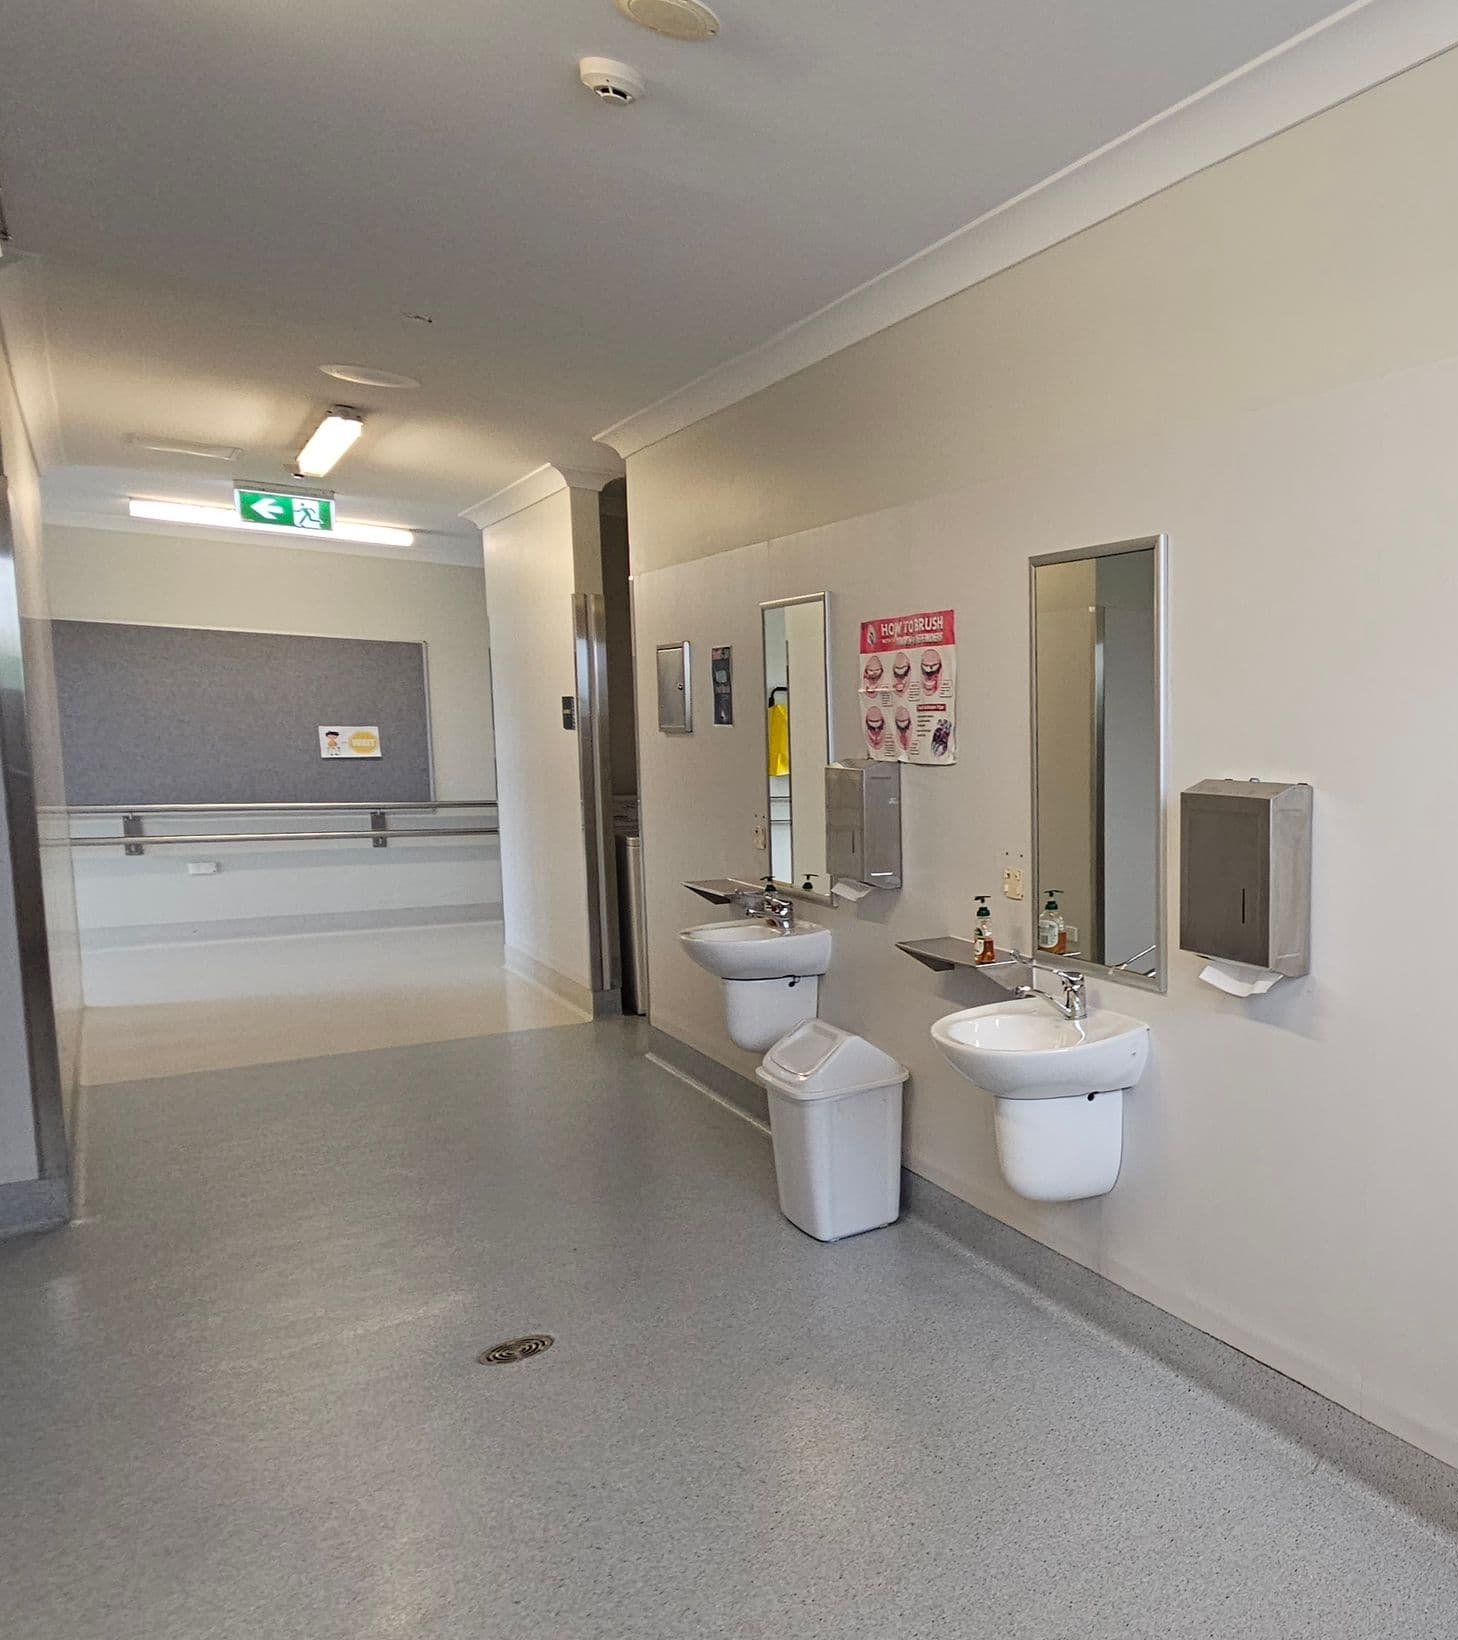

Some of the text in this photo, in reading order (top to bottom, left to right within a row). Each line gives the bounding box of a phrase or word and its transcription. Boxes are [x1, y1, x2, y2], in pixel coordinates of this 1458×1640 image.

[881, 616, 944, 636] HOW TO BRUSH
